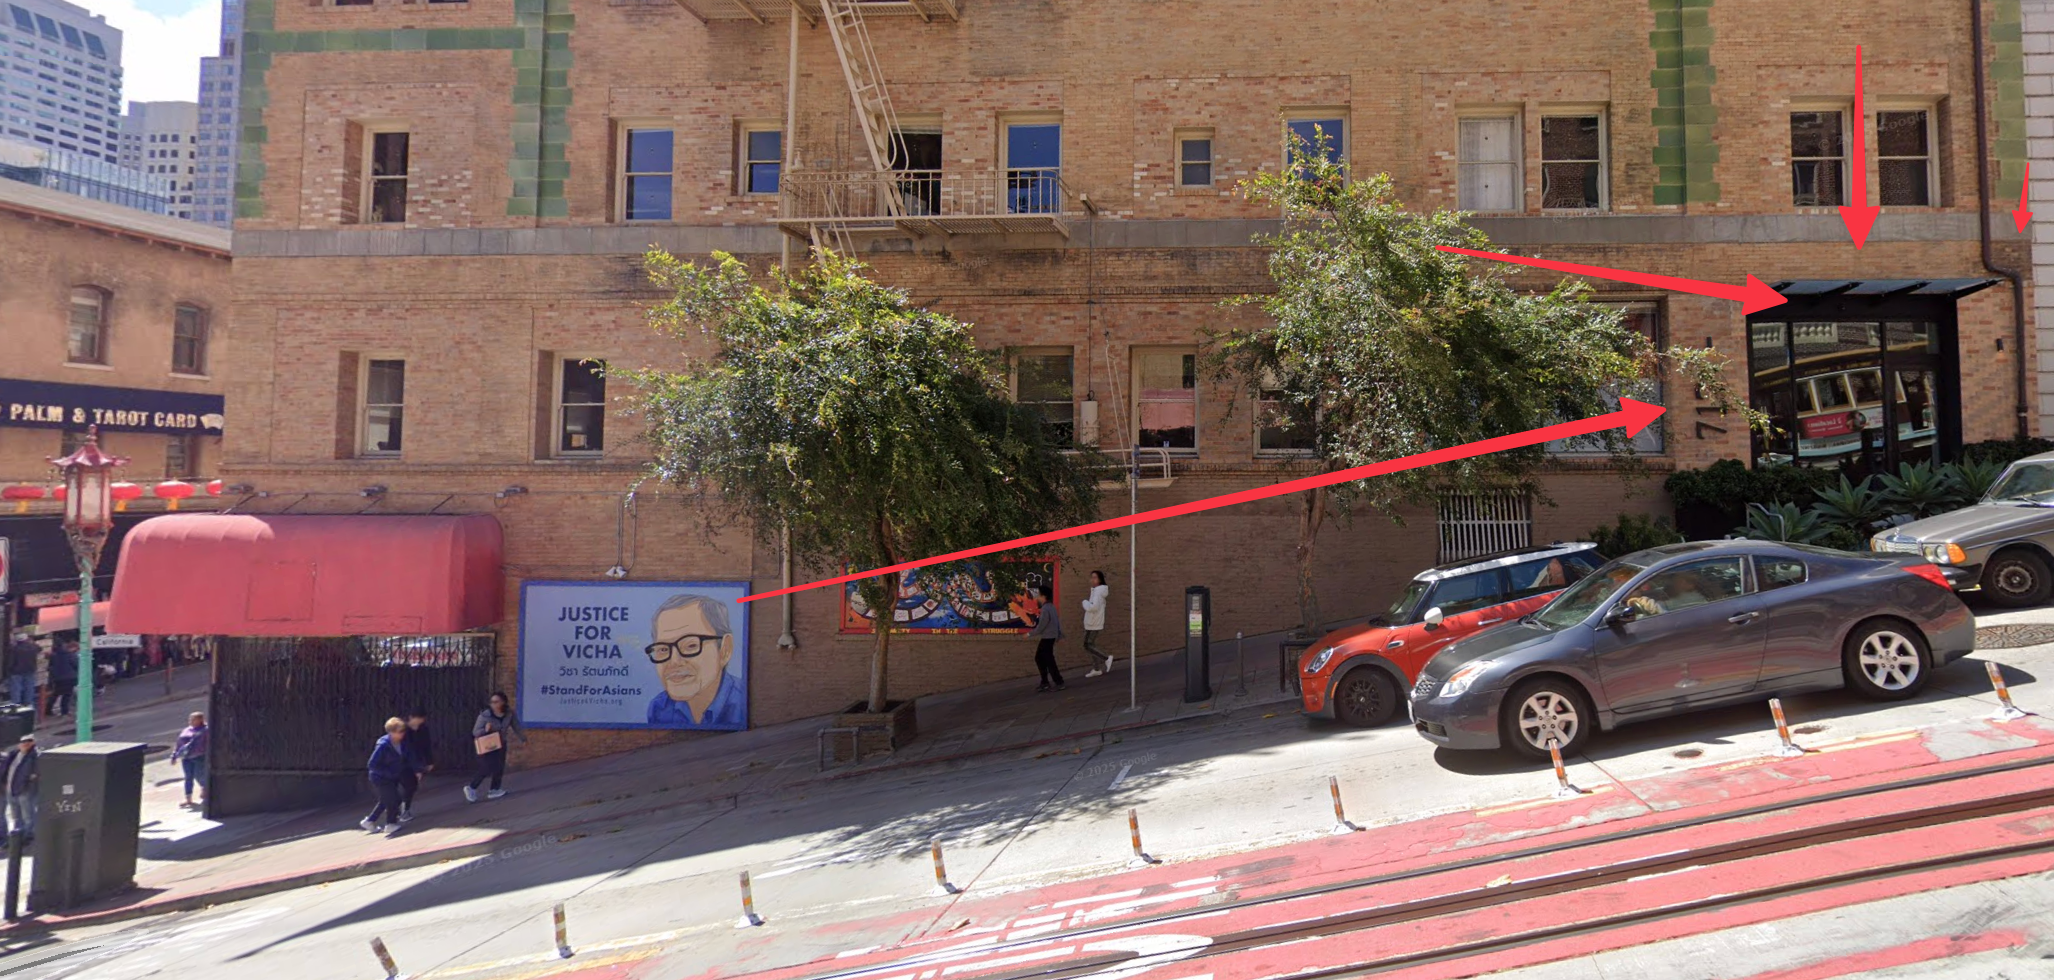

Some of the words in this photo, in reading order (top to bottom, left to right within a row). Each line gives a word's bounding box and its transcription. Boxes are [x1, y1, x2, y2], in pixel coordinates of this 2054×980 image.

[10, 403, 64, 422] PALM
[72, 407, 86, 423] &
[92, 408, 149, 426] TAROT
[154, 411, 197, 428] CARD
[558, 606, 629, 621] JUSTICE
[575, 625, 611, 640] FOR
[563, 644, 622, 659] VICHA
[559, 665, 579, 677] วิชา
[541, 684, 642, 695] #StandForAsians
